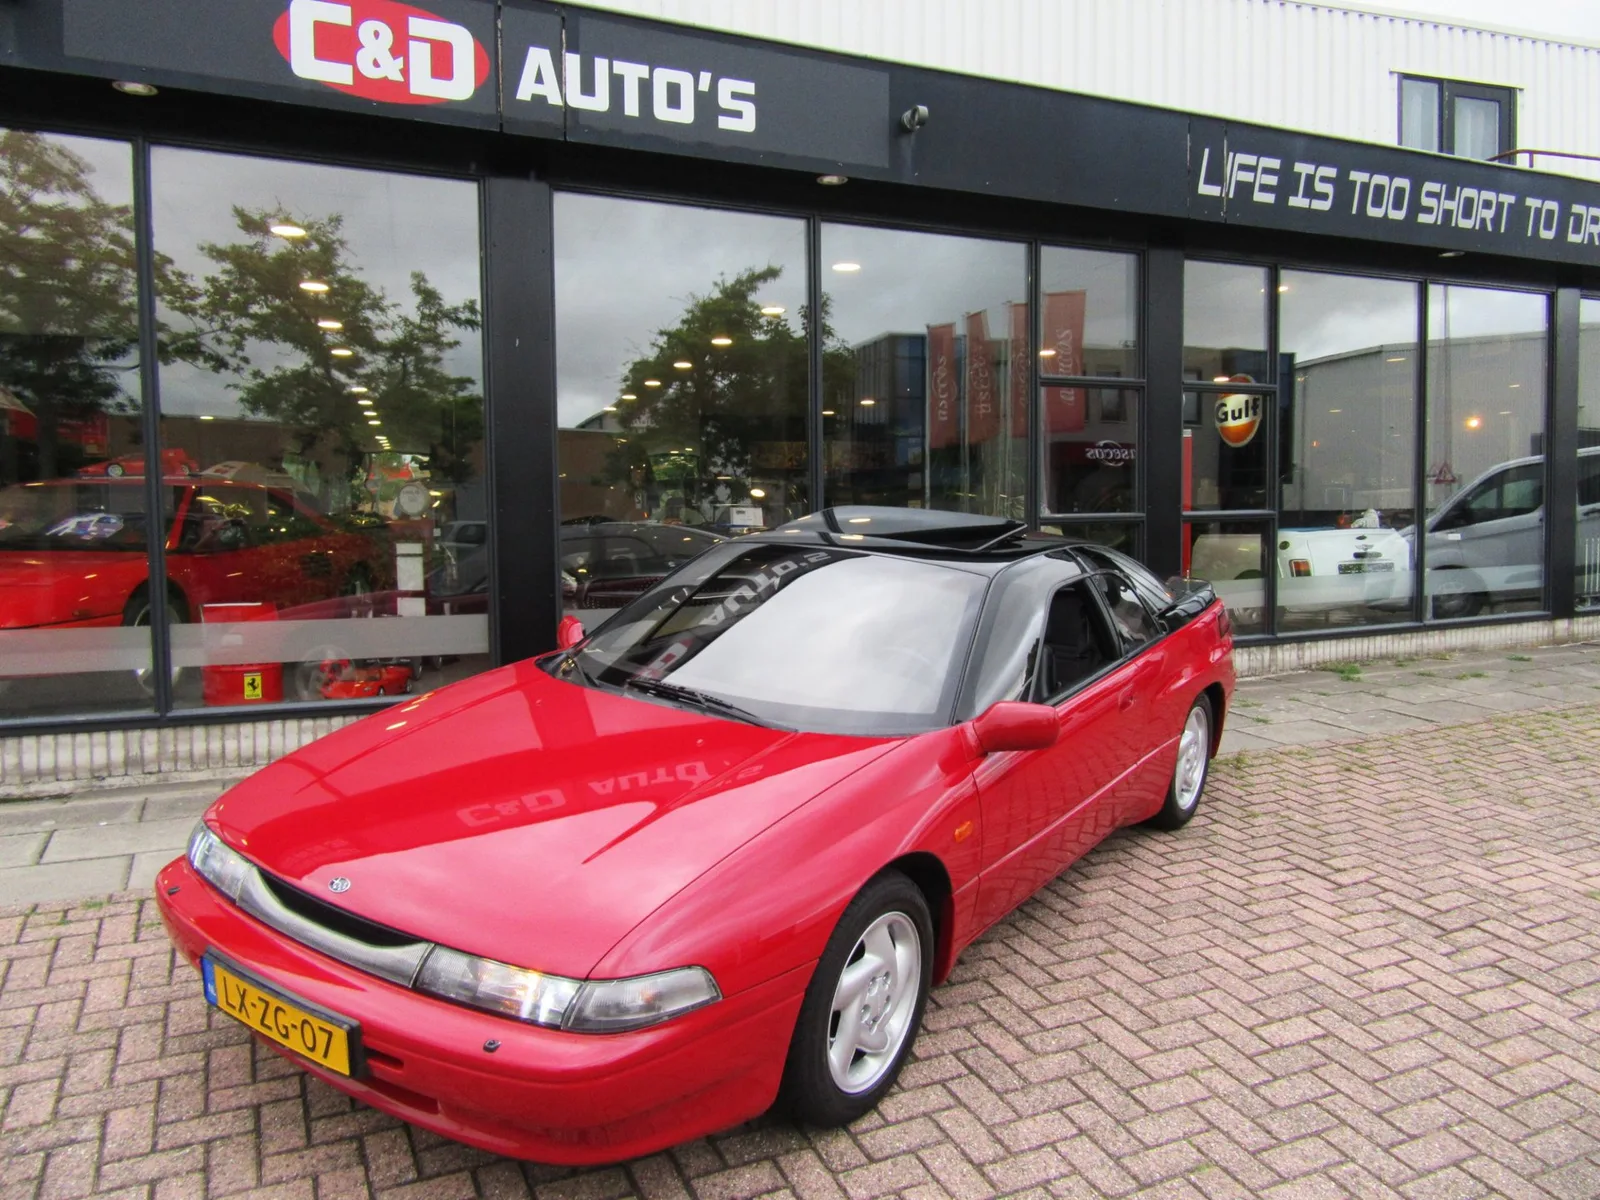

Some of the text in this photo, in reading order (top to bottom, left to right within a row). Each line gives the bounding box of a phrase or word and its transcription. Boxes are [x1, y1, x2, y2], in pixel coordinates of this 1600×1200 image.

[289, 0, 756, 133] C&D AUTO'S
[1197, 147, 1281, 204] LIFE
[1288, 161, 1338, 212] IS
[1349, 170, 1411, 221] TOO
[1417, 181, 1516, 233] SHORT
[1525, 197, 1559, 240] TO
[1215, 396, 1260, 424] Gulf
[222, 975, 334, 1060] LX-ZG-07
